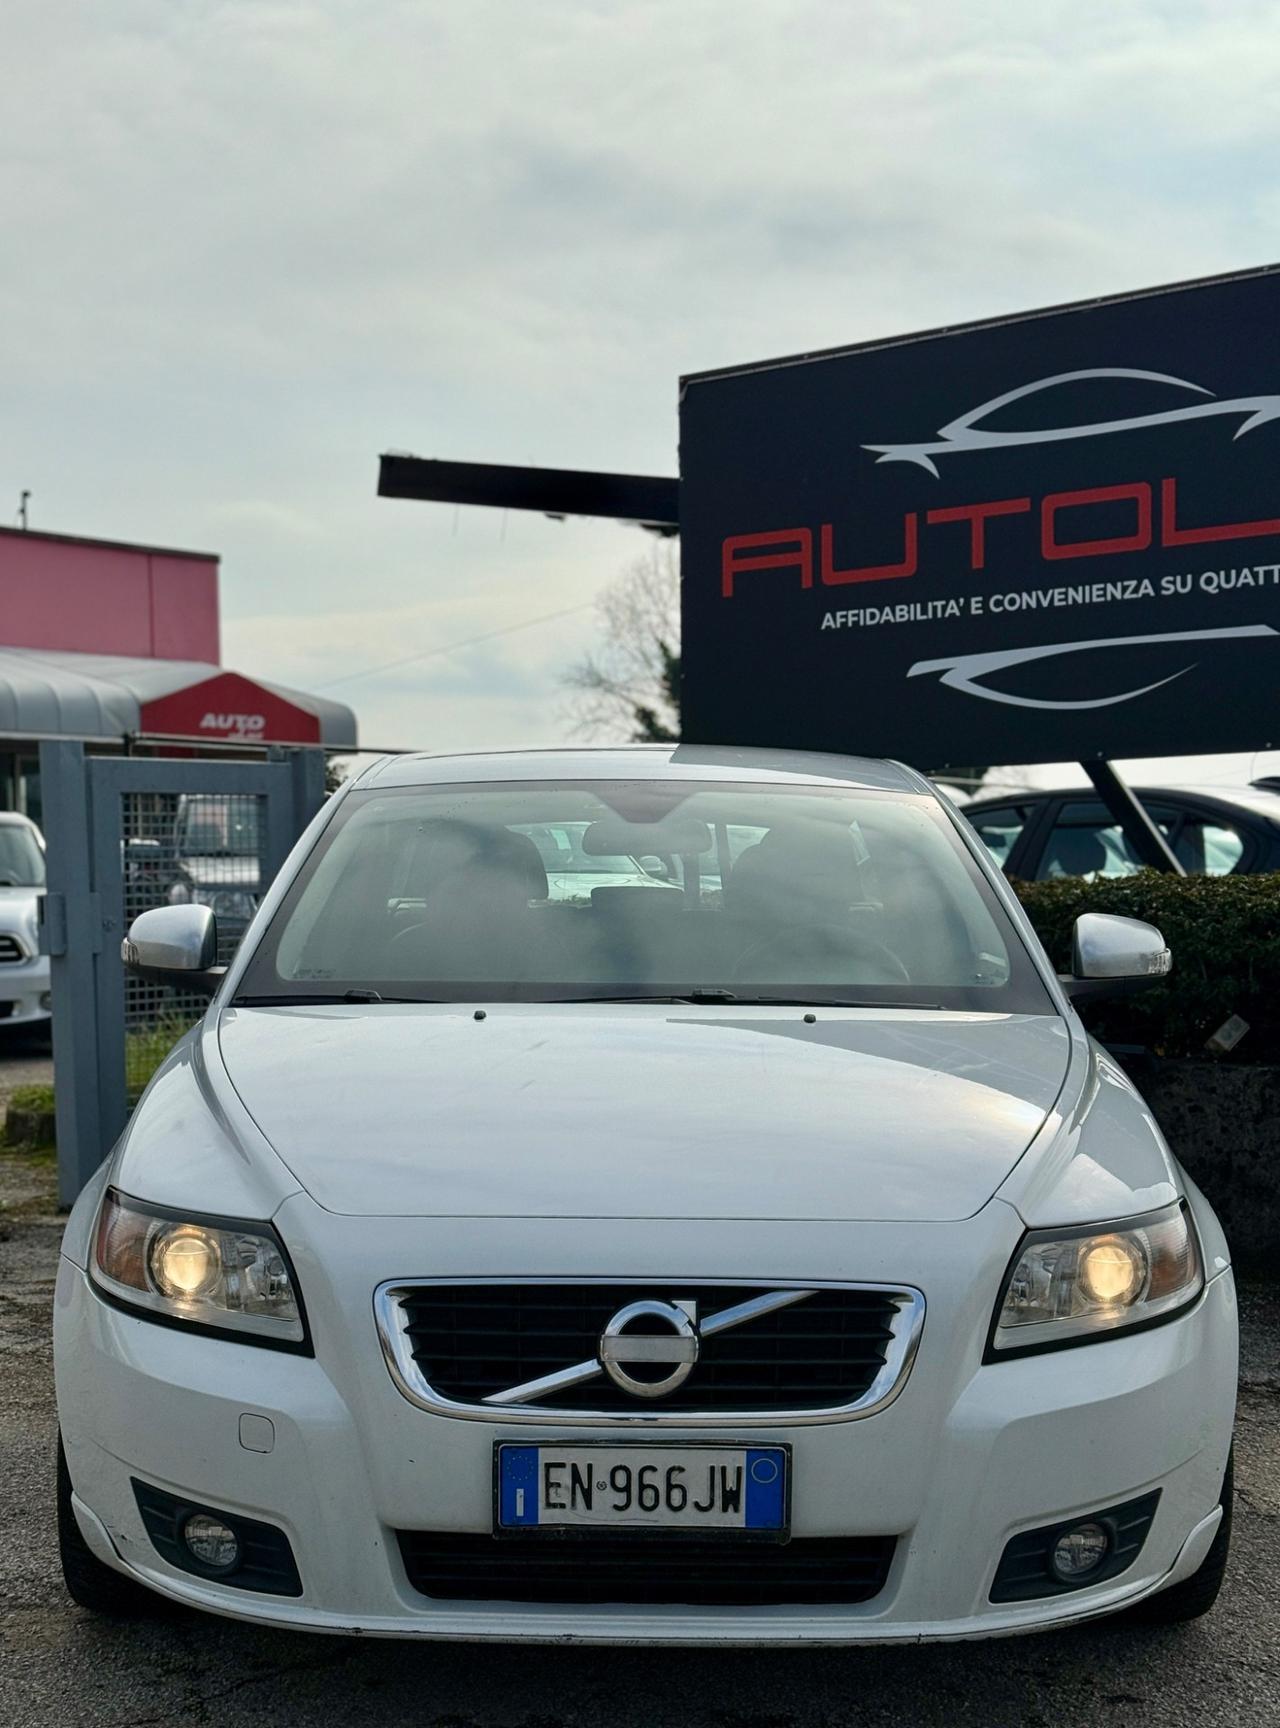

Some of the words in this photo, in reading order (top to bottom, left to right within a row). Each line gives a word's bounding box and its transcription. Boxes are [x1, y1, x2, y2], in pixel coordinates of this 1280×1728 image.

[821, 598, 964, 630] AFFIDABILITA'
[970, 596, 983, 615] E
[989, 578, 1155, 613] CONVENIENZA
[1161, 574, 1192, 595] SU
[199, 712, 266, 729] AUTO
